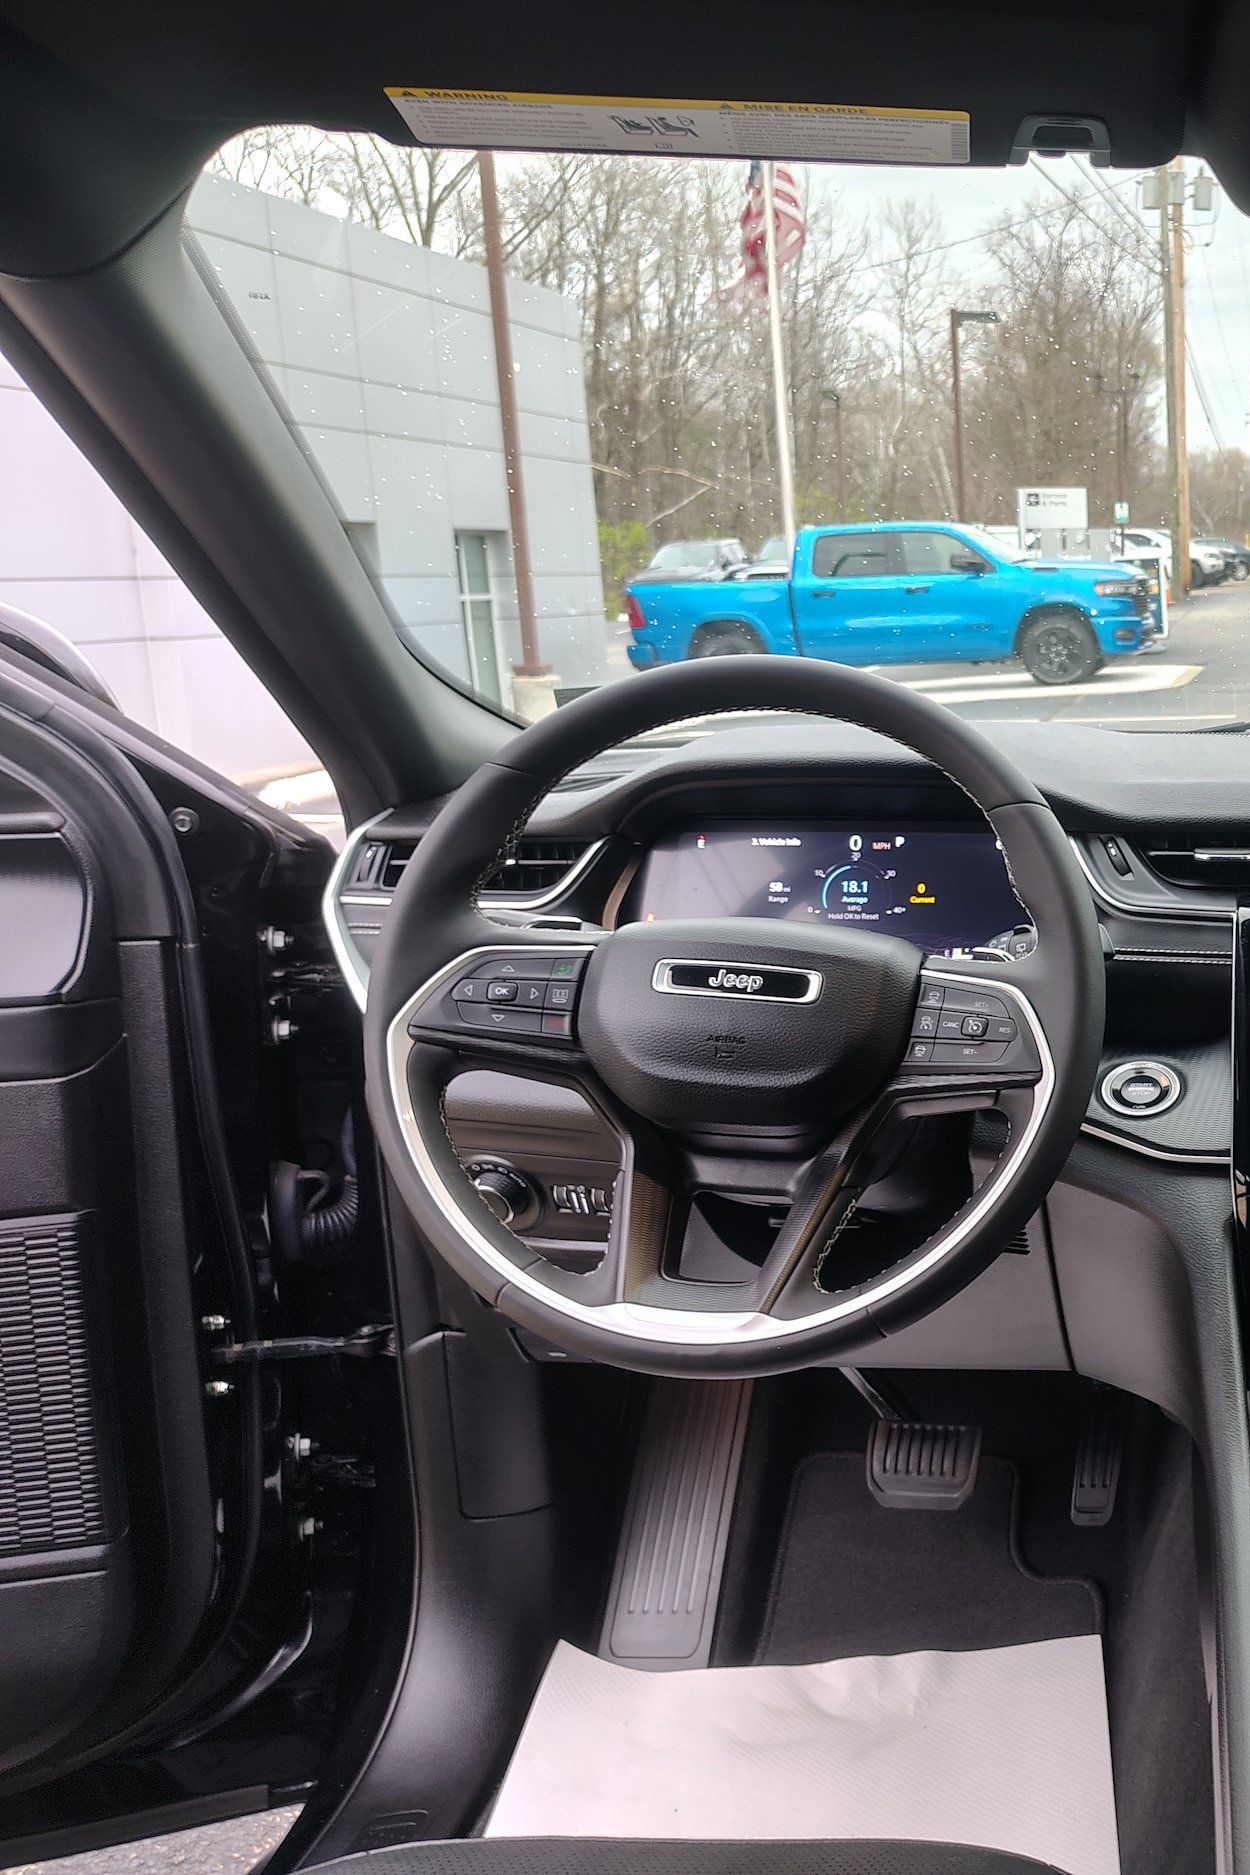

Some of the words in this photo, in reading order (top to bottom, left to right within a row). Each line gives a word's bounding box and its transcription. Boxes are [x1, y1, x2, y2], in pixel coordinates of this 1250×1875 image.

[424, 91, 508, 100] WARNING
[743, 104, 780, 112] MISE
[787, 105, 809, 113] EN
[815, 106, 869, 115] GARDE
[849, 835, 862, 851] 0
[872, 842, 891, 850] MPH
[895, 836, 905, 847] P
[841, 881, 869, 893] 18.1
[917, 883, 926, 894] 0
[768, 895, 789, 904] Range
[708, 969, 764, 992] Jeep
[495, 987, 509, 995] OK
[942, 1021, 960, 1029] CANC
[999, 1026, 1012, 1034] RES
[706, 1034, 748, 1045] AIRBAG
